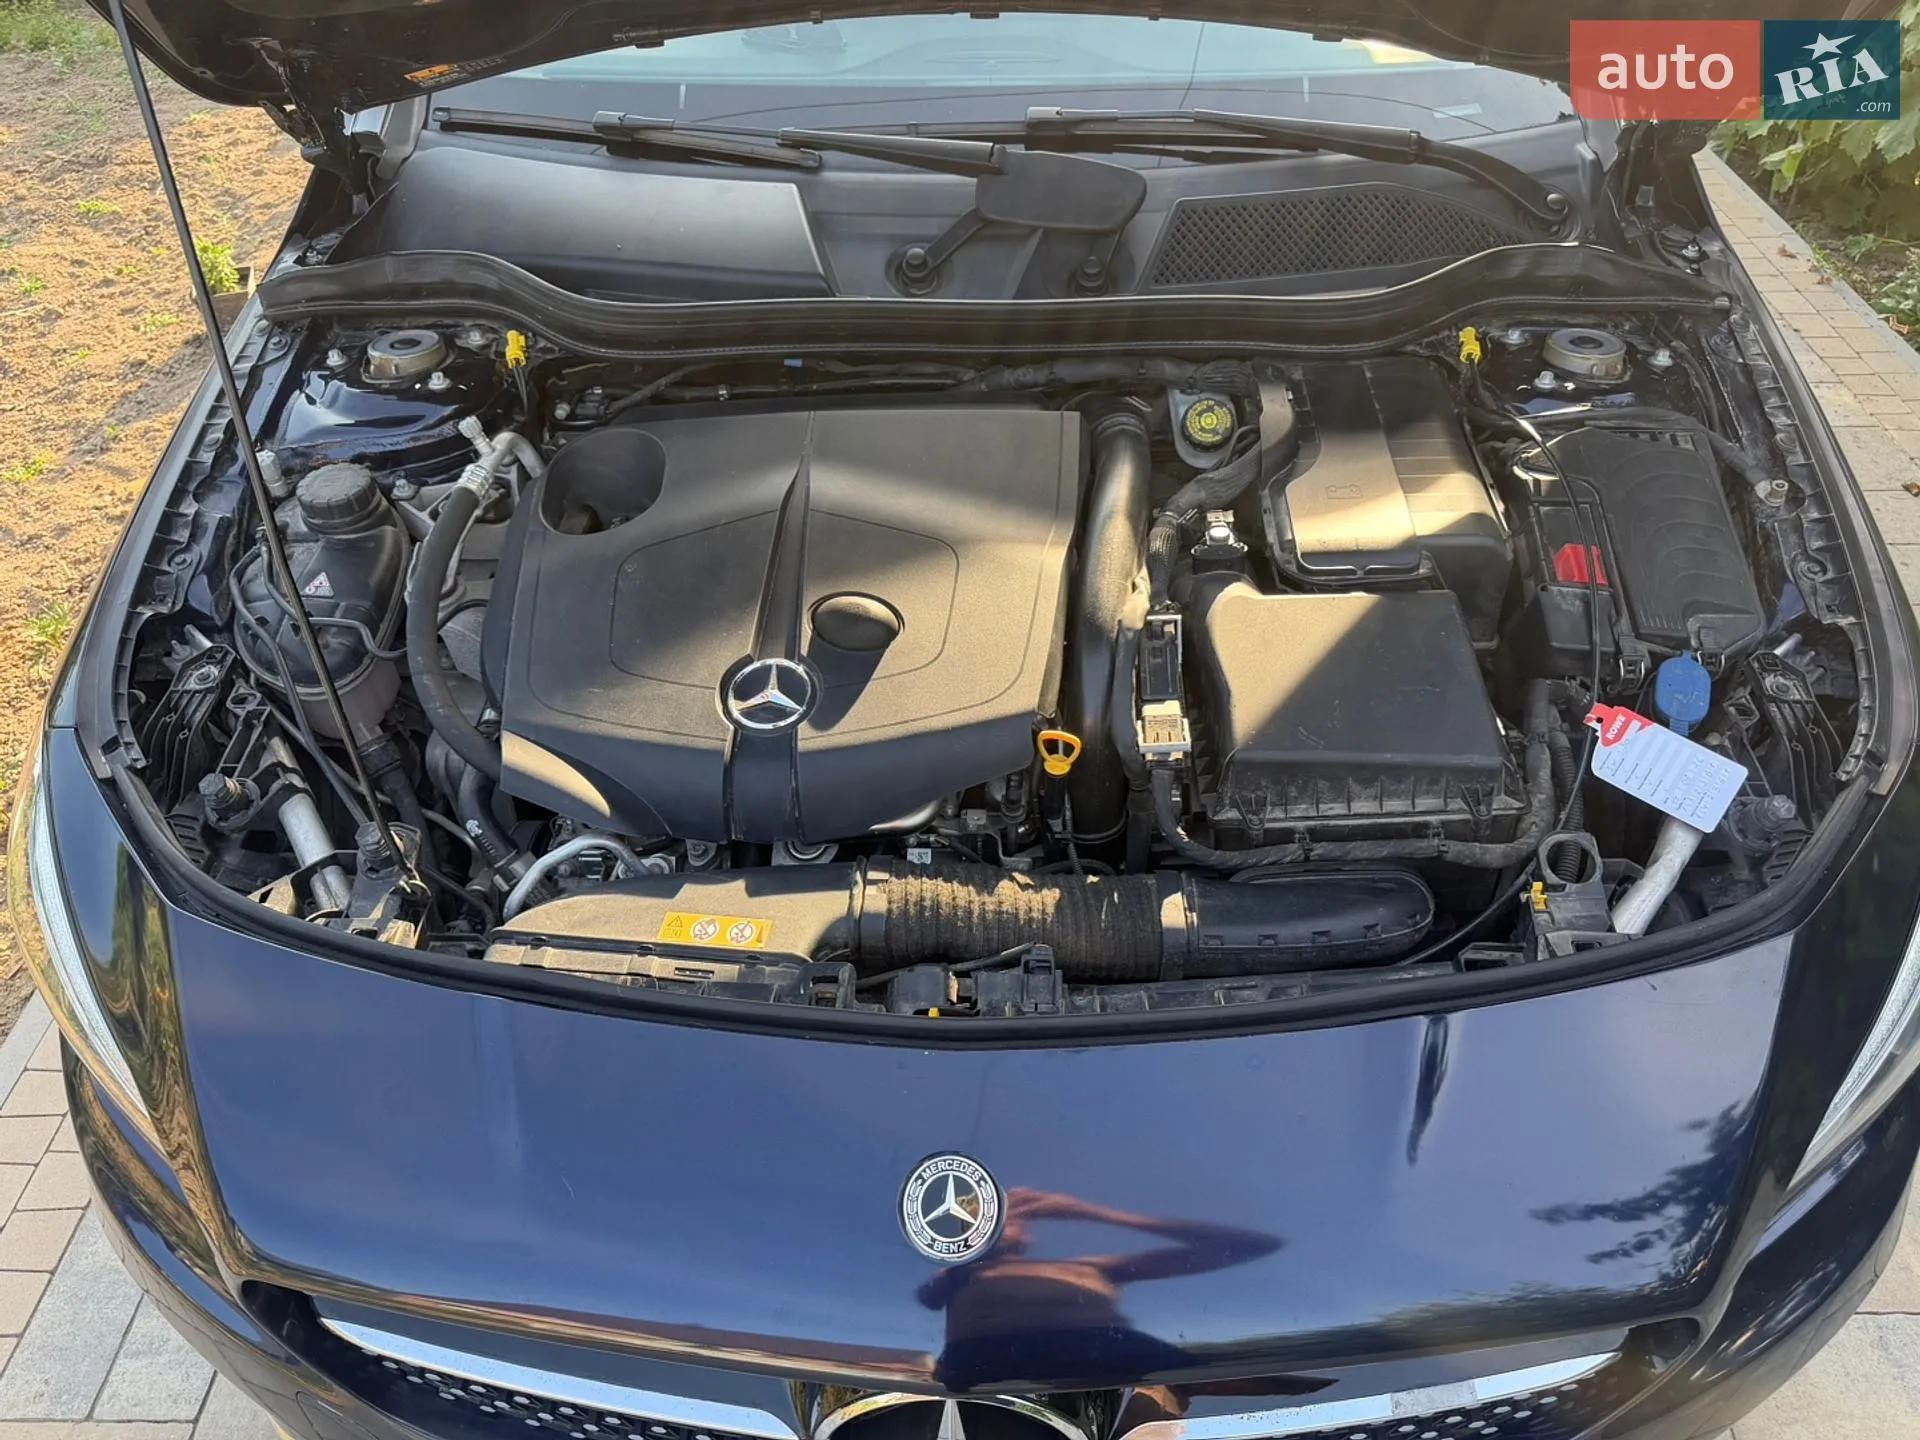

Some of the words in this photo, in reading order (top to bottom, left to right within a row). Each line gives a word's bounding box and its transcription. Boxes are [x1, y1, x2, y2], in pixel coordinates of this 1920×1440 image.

[1606, 715, 1626, 739] ROWE
[922, 1160, 981, 1180] MERCEDES
[933, 1241, 967, 1253] BENZ
